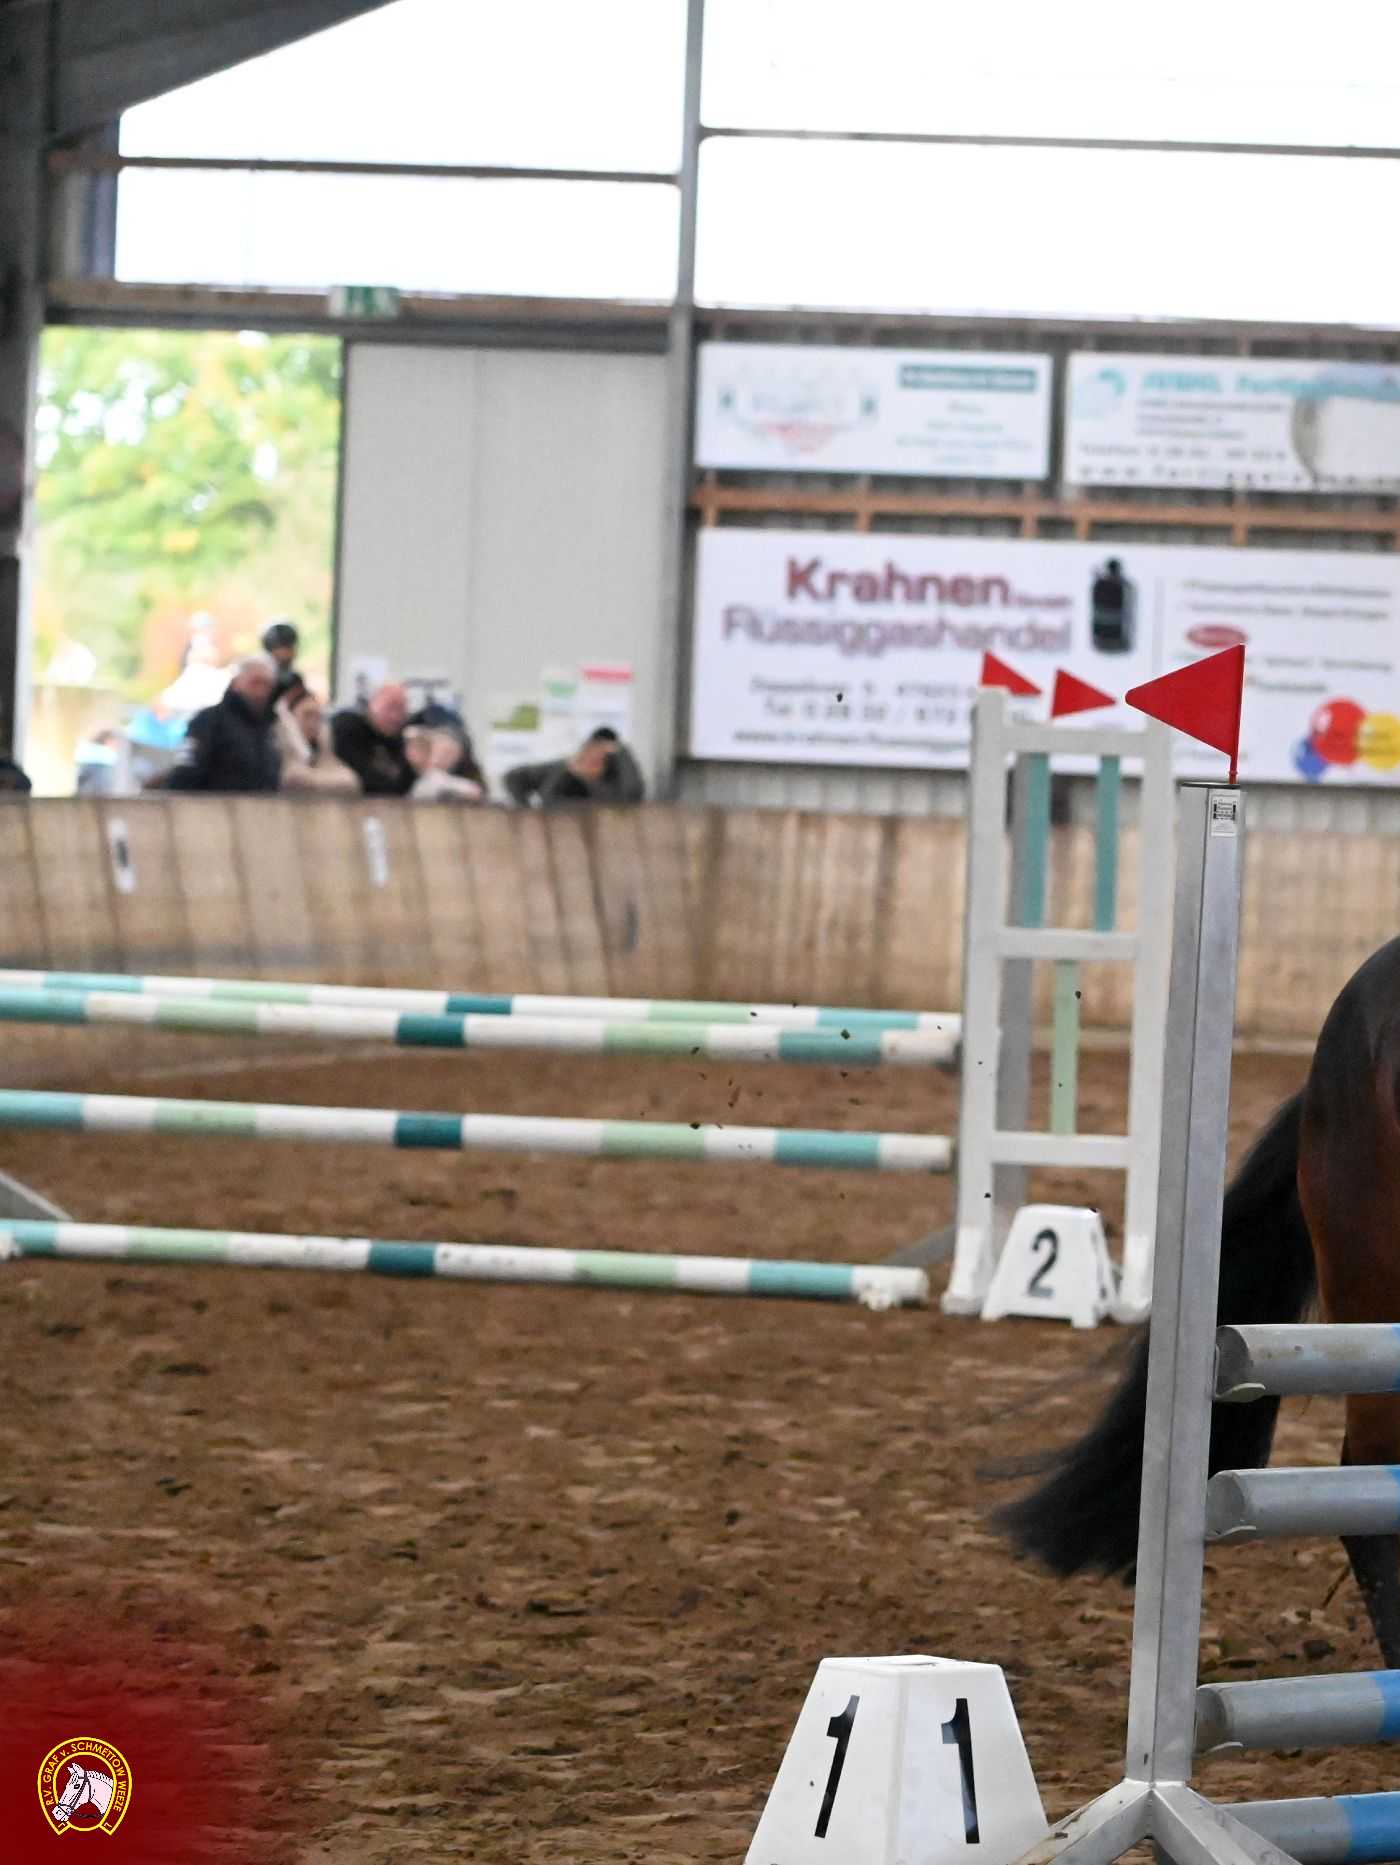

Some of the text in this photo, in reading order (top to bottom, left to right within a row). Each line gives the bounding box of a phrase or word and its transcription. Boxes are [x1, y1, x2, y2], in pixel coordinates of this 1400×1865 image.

[786, 557, 1011, 606] Krahnen
[1027, 1228, 1059, 1298] 2
[814, 1695, 860, 1838] 1
[941, 1698, 980, 1844] 1
